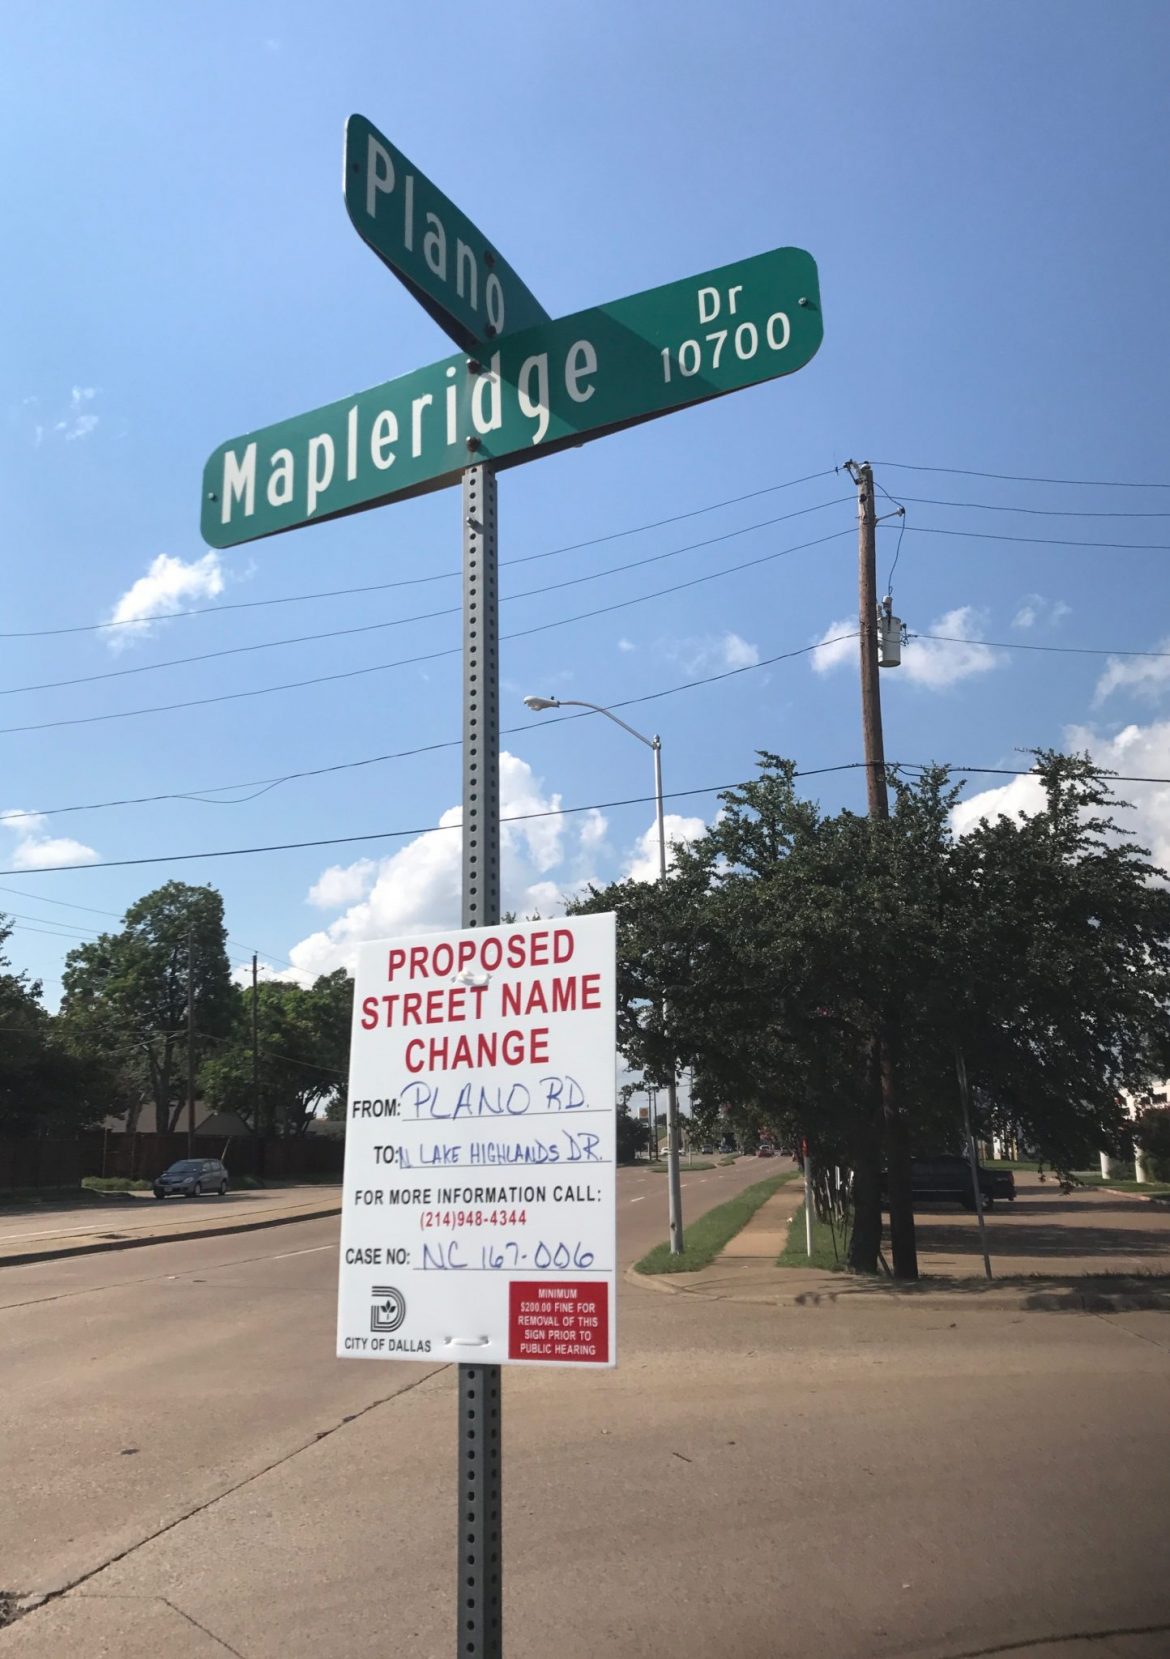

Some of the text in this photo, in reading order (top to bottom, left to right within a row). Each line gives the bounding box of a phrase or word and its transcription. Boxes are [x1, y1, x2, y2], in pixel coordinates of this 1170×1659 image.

[366, 134, 505, 334] Plano
[698, 285, 743, 325] Dr
[660, 312, 792, 383] 10700
[220, 339, 599, 525] Mapleridge
[388, 929, 575, 982] PROPOSED
[361, 974, 601, 1030] STREET NAME
[405, 1028, 550, 1073] CHANGE
[352, 1076, 589, 1120] FROM: PLANO RD.
[373, 1145, 399, 1164] TO:
[420, 1143, 461, 1165] LAKE
[470, 1139, 560, 1165] HIGHLANDS
[354, 1185, 601, 1205] FOR MORE INFORMATION CALL:
[420, 1209, 527, 1231] (214)948-4344
[345, 1248, 382, 1265] CASE
[386, 1248, 410, 1265] NO:
[422, 1240, 468, 1270] NC
[520, 1301, 596, 1313] $200.00 FINE FOR
[538, 1288, 578, 1299] MINIMUM
[517, 1315, 598, 1328] REMOVAL OF THIS
[524, 1329, 592, 1341] SIGN PRIOR TO
[344, 1337, 432, 1352] CITY OF DALLAS
[520, 1343, 597, 1356] PUBLIC HEARING
